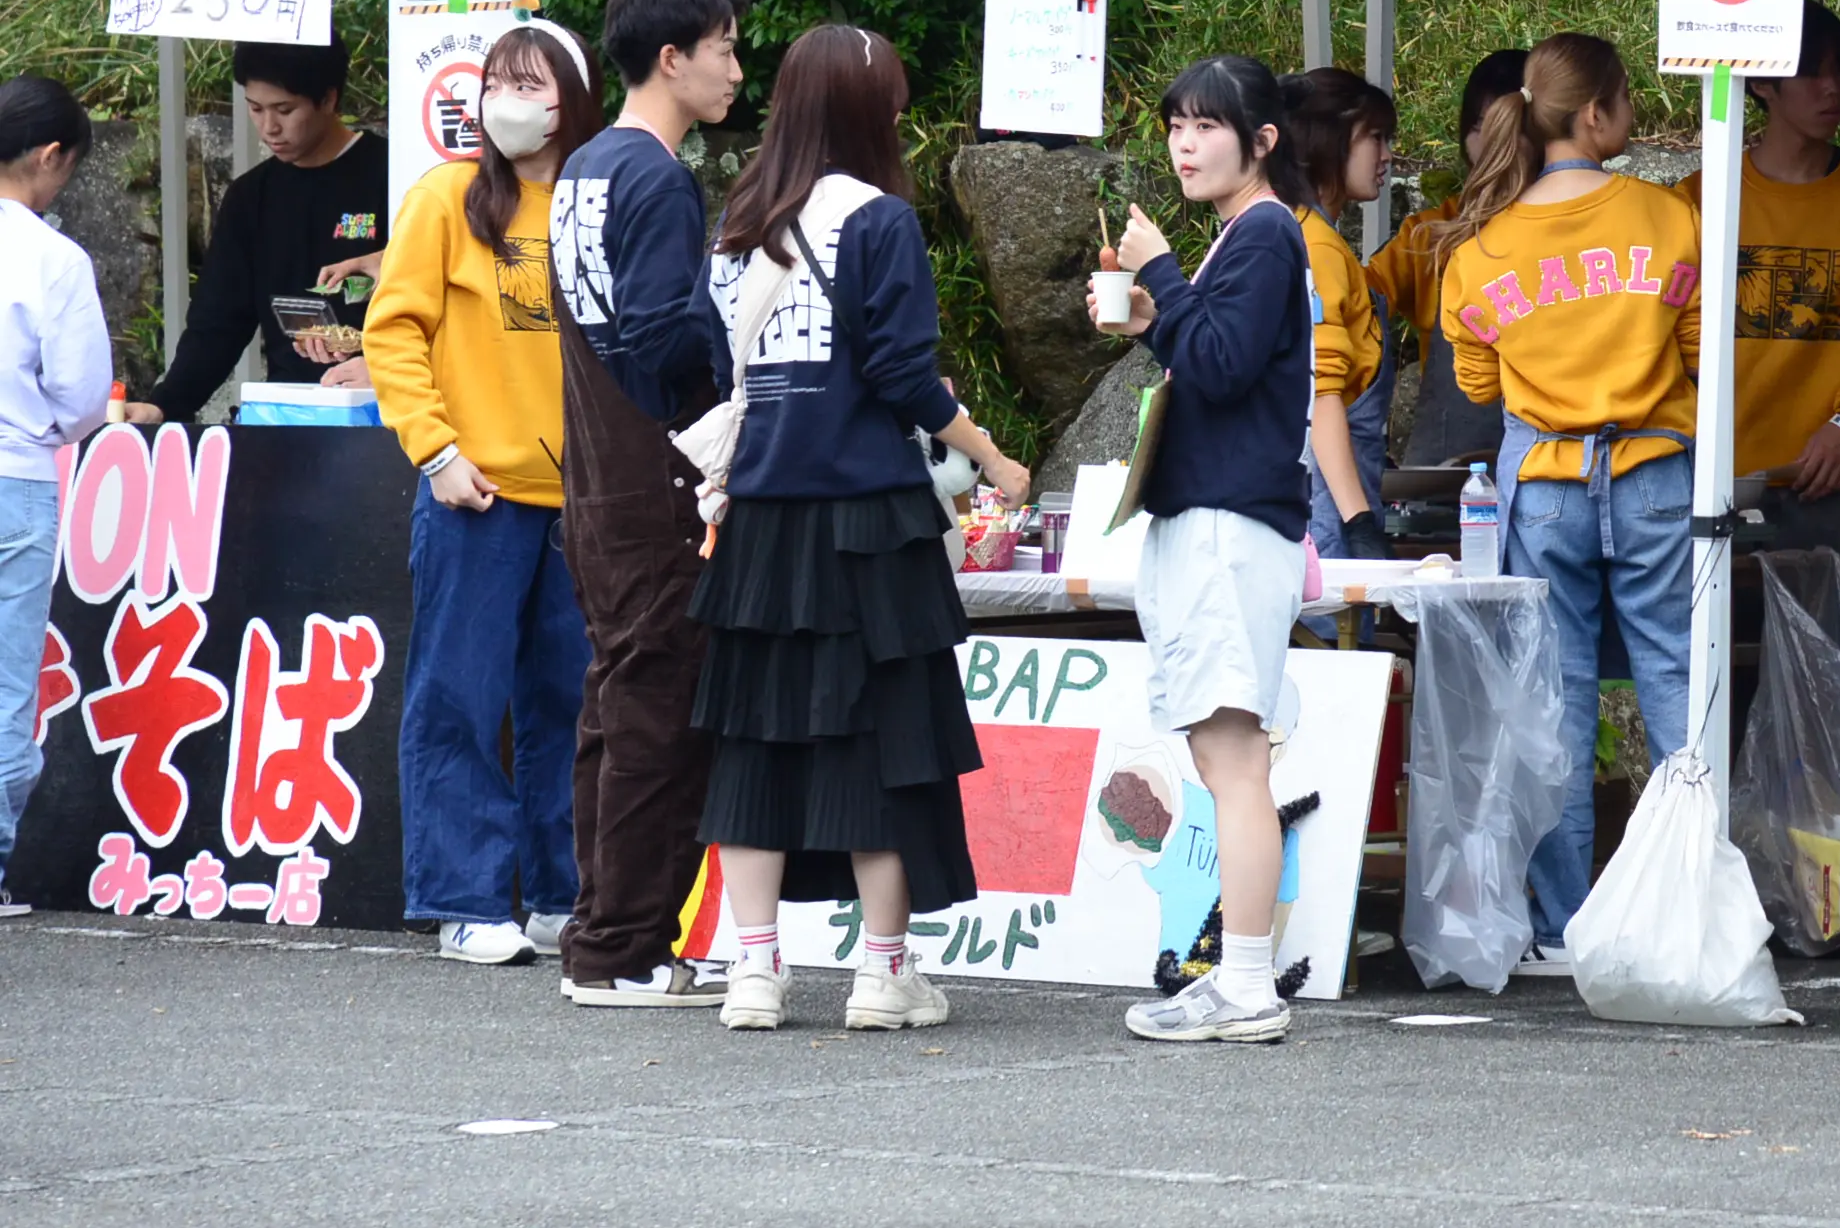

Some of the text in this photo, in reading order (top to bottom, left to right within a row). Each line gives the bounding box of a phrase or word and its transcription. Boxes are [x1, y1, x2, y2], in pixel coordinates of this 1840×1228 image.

[341, 212, 376, 226] SUPER
[333, 222, 377, 240] ALBION
[89, 832, 329, 926] みっちー店
